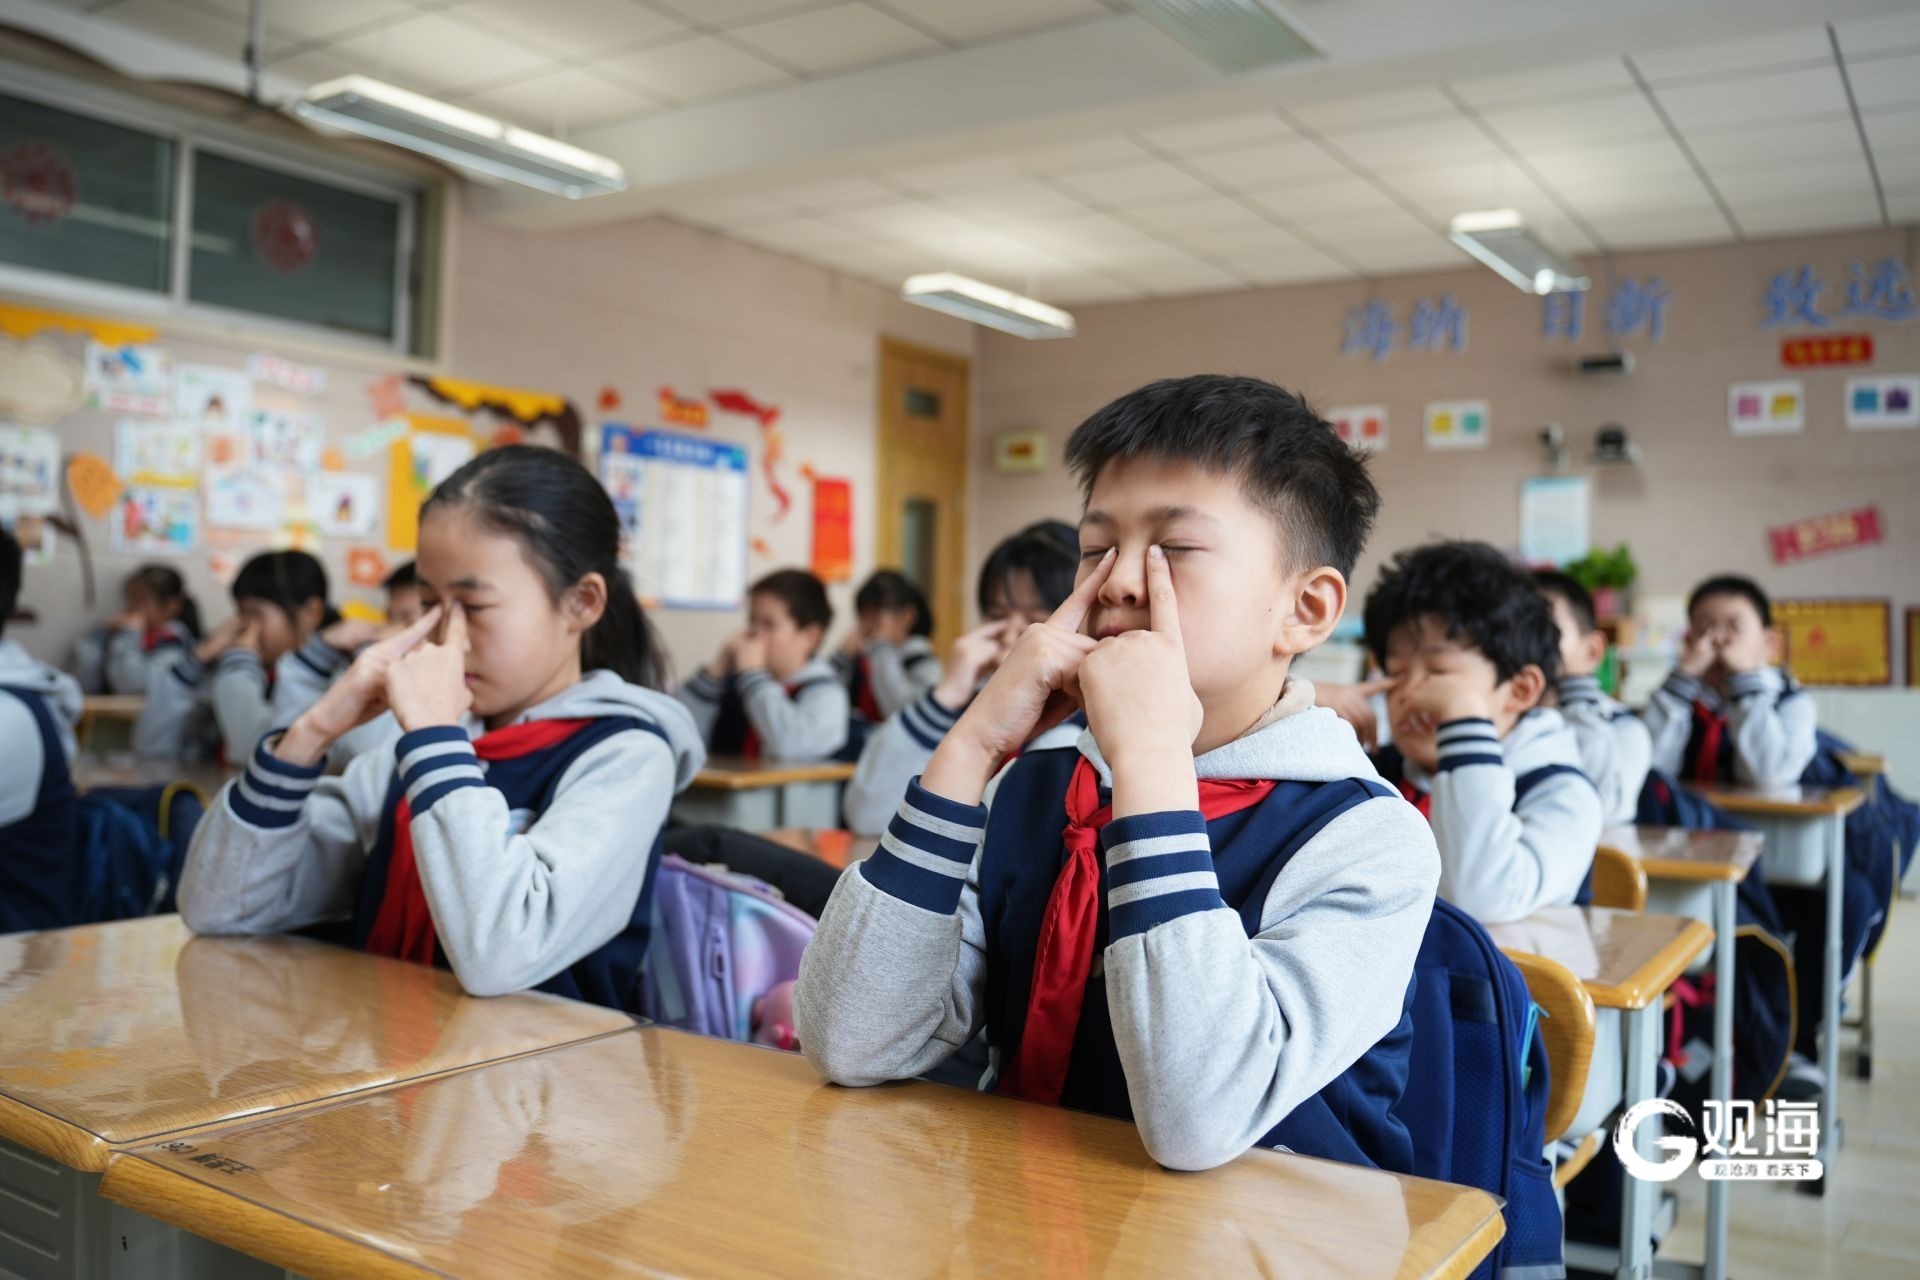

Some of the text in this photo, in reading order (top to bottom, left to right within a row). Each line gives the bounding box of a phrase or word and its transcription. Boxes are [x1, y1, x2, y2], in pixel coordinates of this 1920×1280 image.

[1340, 257, 1920, 361] 海纳 日新 致远
